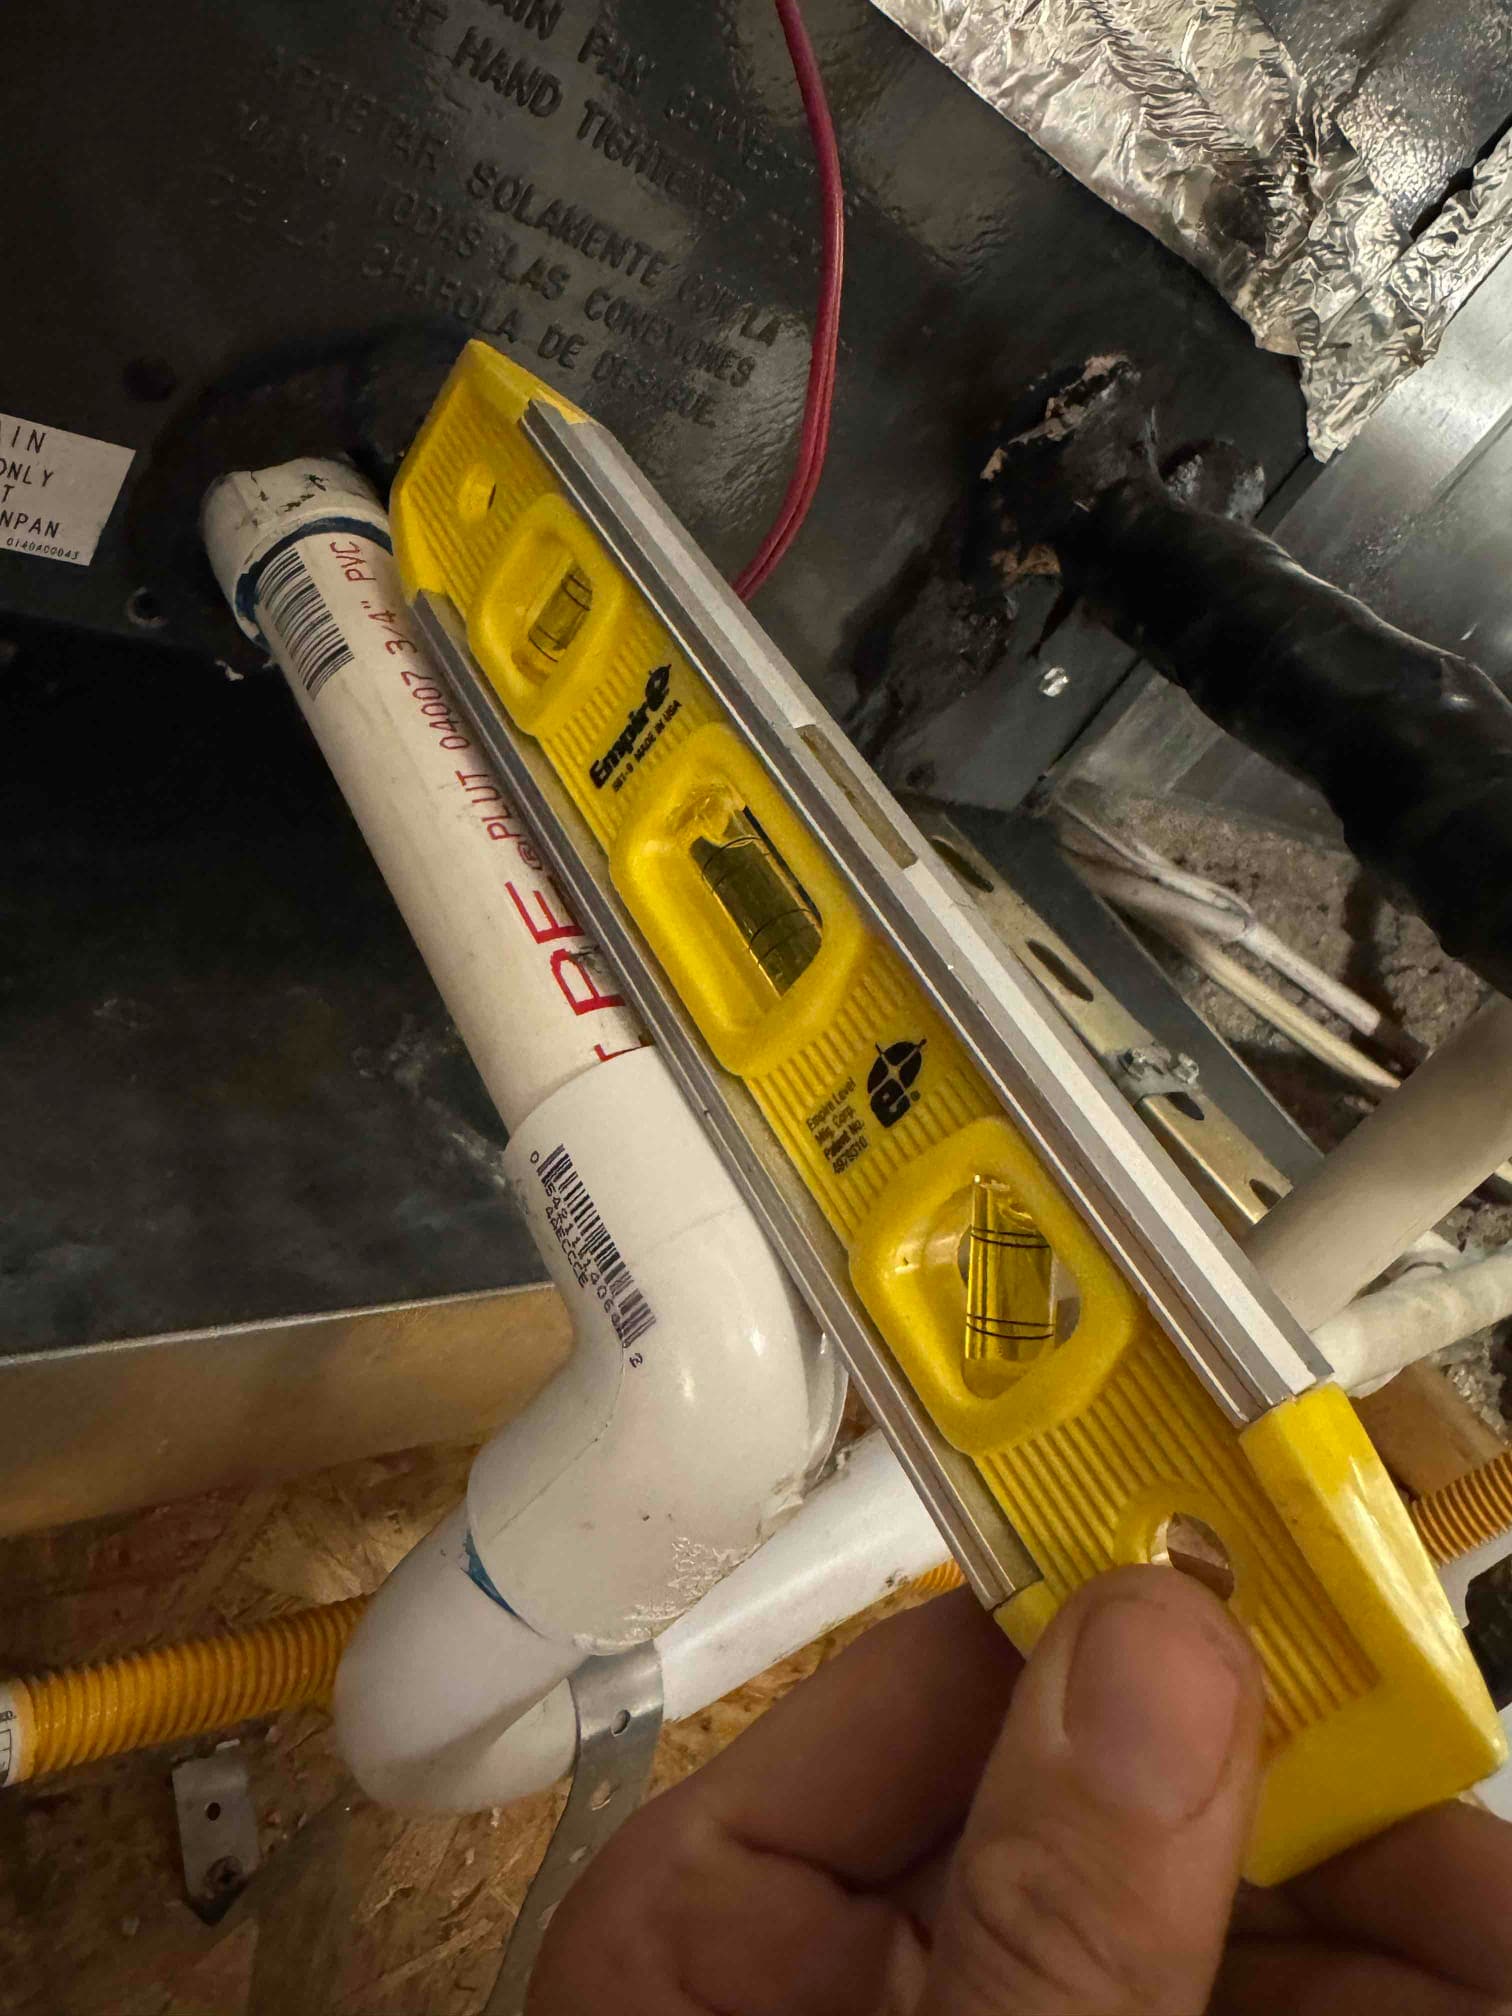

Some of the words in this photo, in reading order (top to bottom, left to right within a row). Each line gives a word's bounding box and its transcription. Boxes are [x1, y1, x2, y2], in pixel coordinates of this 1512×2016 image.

[451, 25, 565, 118] HAND
[499, 243, 571, 300] LAS
[537, 330, 588, 369] DE
[0, 420, 46, 454] IN
[329, 541, 377, 582] PVC
[360, 600, 418, 655] 3/4"
[400, 671, 471, 750] 04007
[589, 664, 672, 789] Empire
[455, 770, 521, 840] PLUT
[529, 1150, 540, 1164] 0
[629, 1352, 644, 1369] 2
